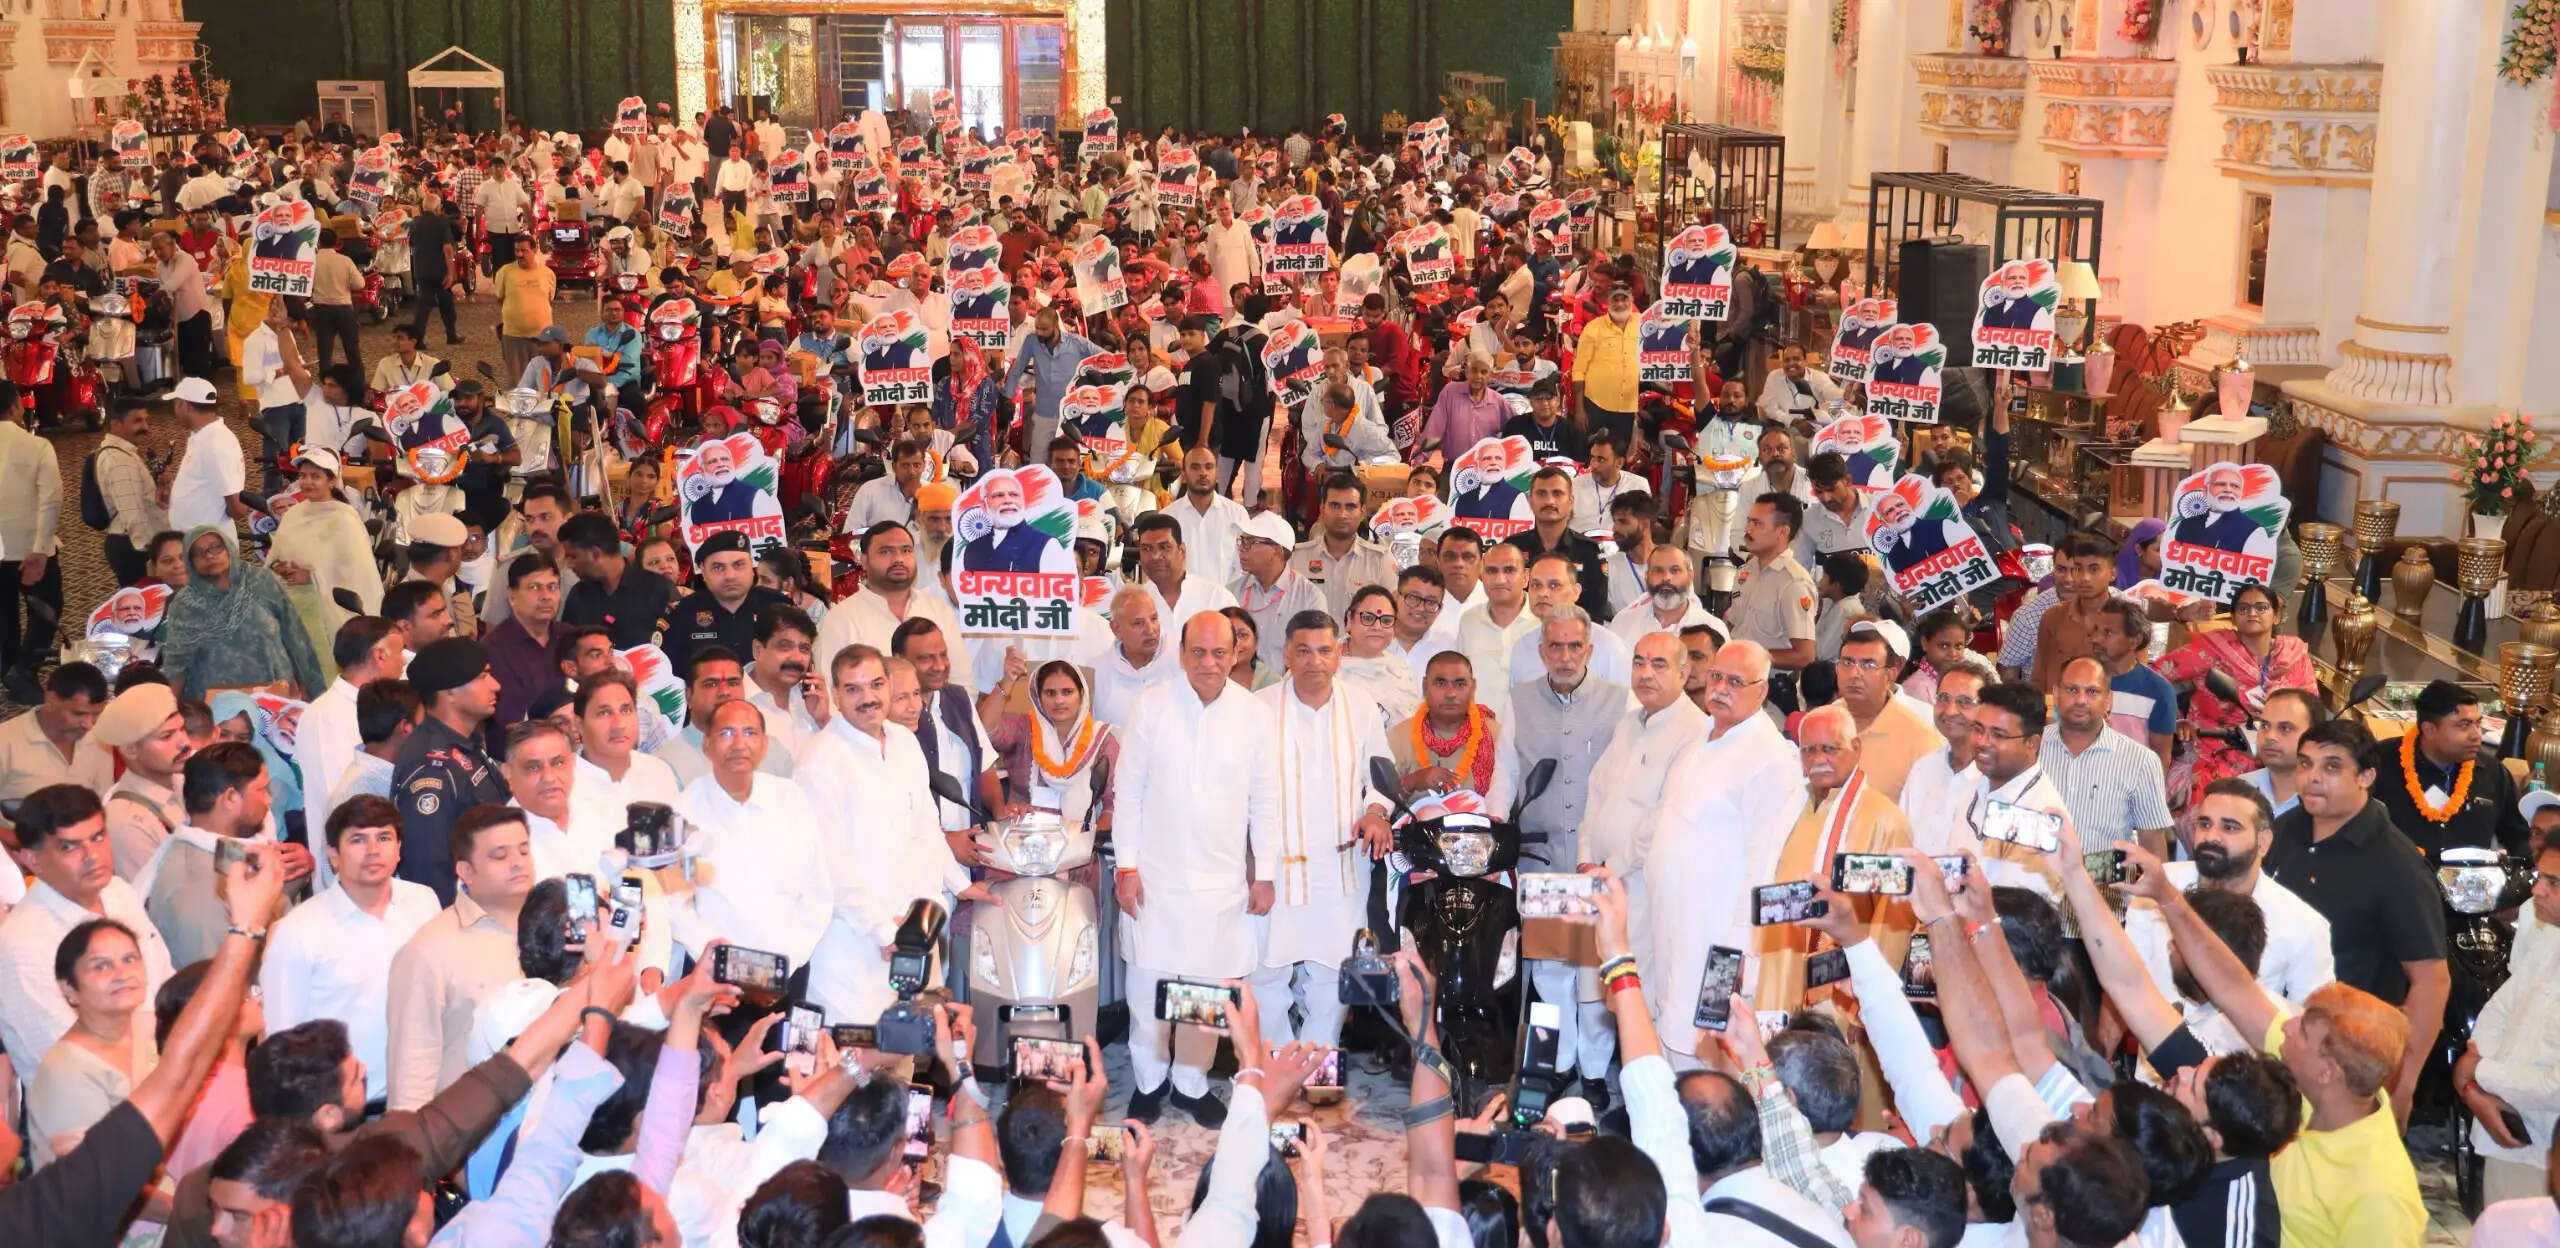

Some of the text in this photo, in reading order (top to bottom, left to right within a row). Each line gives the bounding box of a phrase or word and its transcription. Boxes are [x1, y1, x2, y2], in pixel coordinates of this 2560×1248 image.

[1274, 244, 1326, 255] धन्यवाद
[252, 257, 313, 277] धन्यवाद
[1276, 254, 1324, 270] मोदी जी
[252, 272, 308, 294] मोदी जी
[1665, 284, 1730, 302] धन्यवाद
[1664, 299, 1727, 317] मोदी जी
[952, 319, 1008, 333] धन्यवाद
[988, 332, 1006, 346] जी
[1977, 326, 2052, 348] धन्यवाद
[1976, 346, 2047, 368] मोदी जी
[865, 368, 929, 384] धन्यवाद
[1642, 364, 1676, 380] मोदी
[1833, 360, 1865, 379] मोदी
[867, 382, 927, 402] मोदी जी
[1870, 382, 1939, 404] धन्यवाद
[1870, 399, 1935, 420] मोदी जी
[1534, 441, 1558, 451] BULL
[1894, 536, 1985, 590] धन्यवाद
[1962, 558, 1992, 584] जी
[2166, 540, 2273, 582] धन्यवाद
[959, 571, 1076, 601] धन्यवाद
[2163, 565, 2225, 597] मोदी
[964, 597, 1072, 630] मोदी जी
